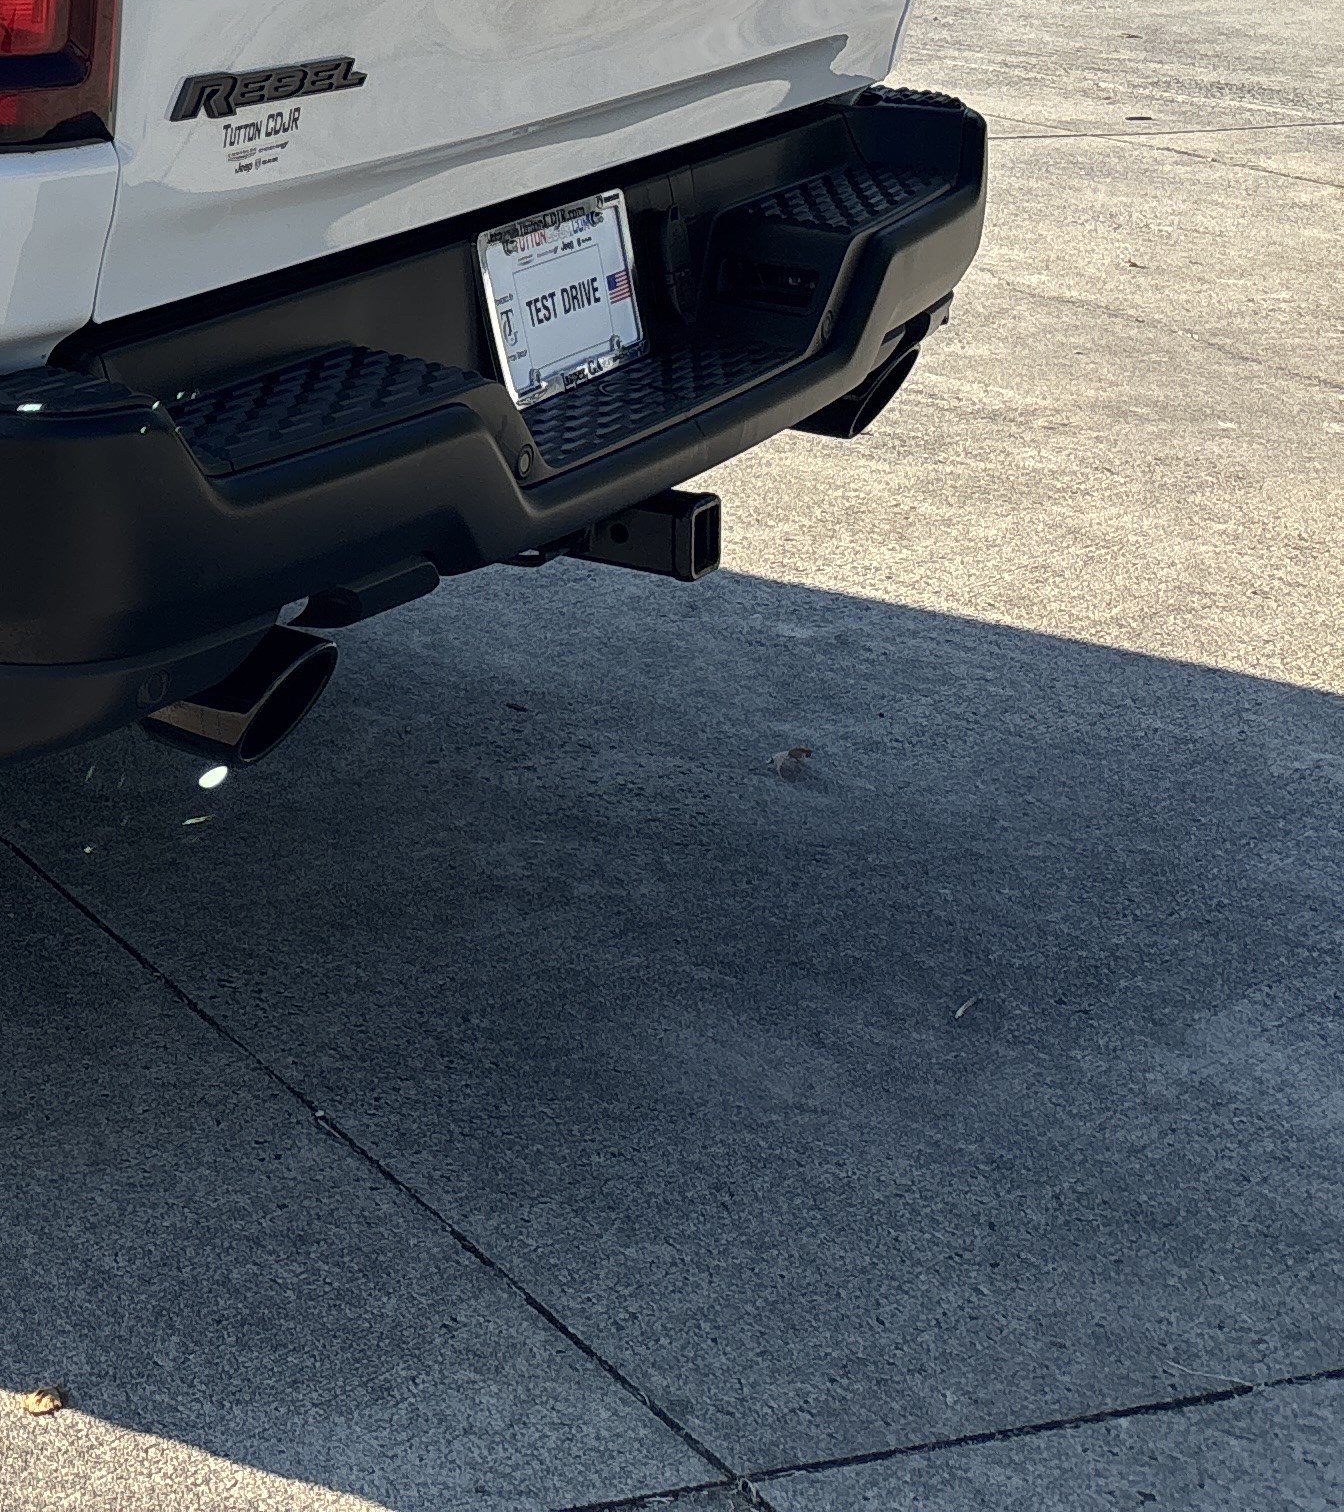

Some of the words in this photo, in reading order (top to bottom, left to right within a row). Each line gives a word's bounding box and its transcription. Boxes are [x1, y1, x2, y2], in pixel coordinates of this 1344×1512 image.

[167, 55, 368, 122] REBEL
[223, 119, 262, 148] TUTTON
[265, 107, 301, 137] CDJR
[526, 291, 557, 327] TEST
[561, 277, 601, 315] DRIVE
